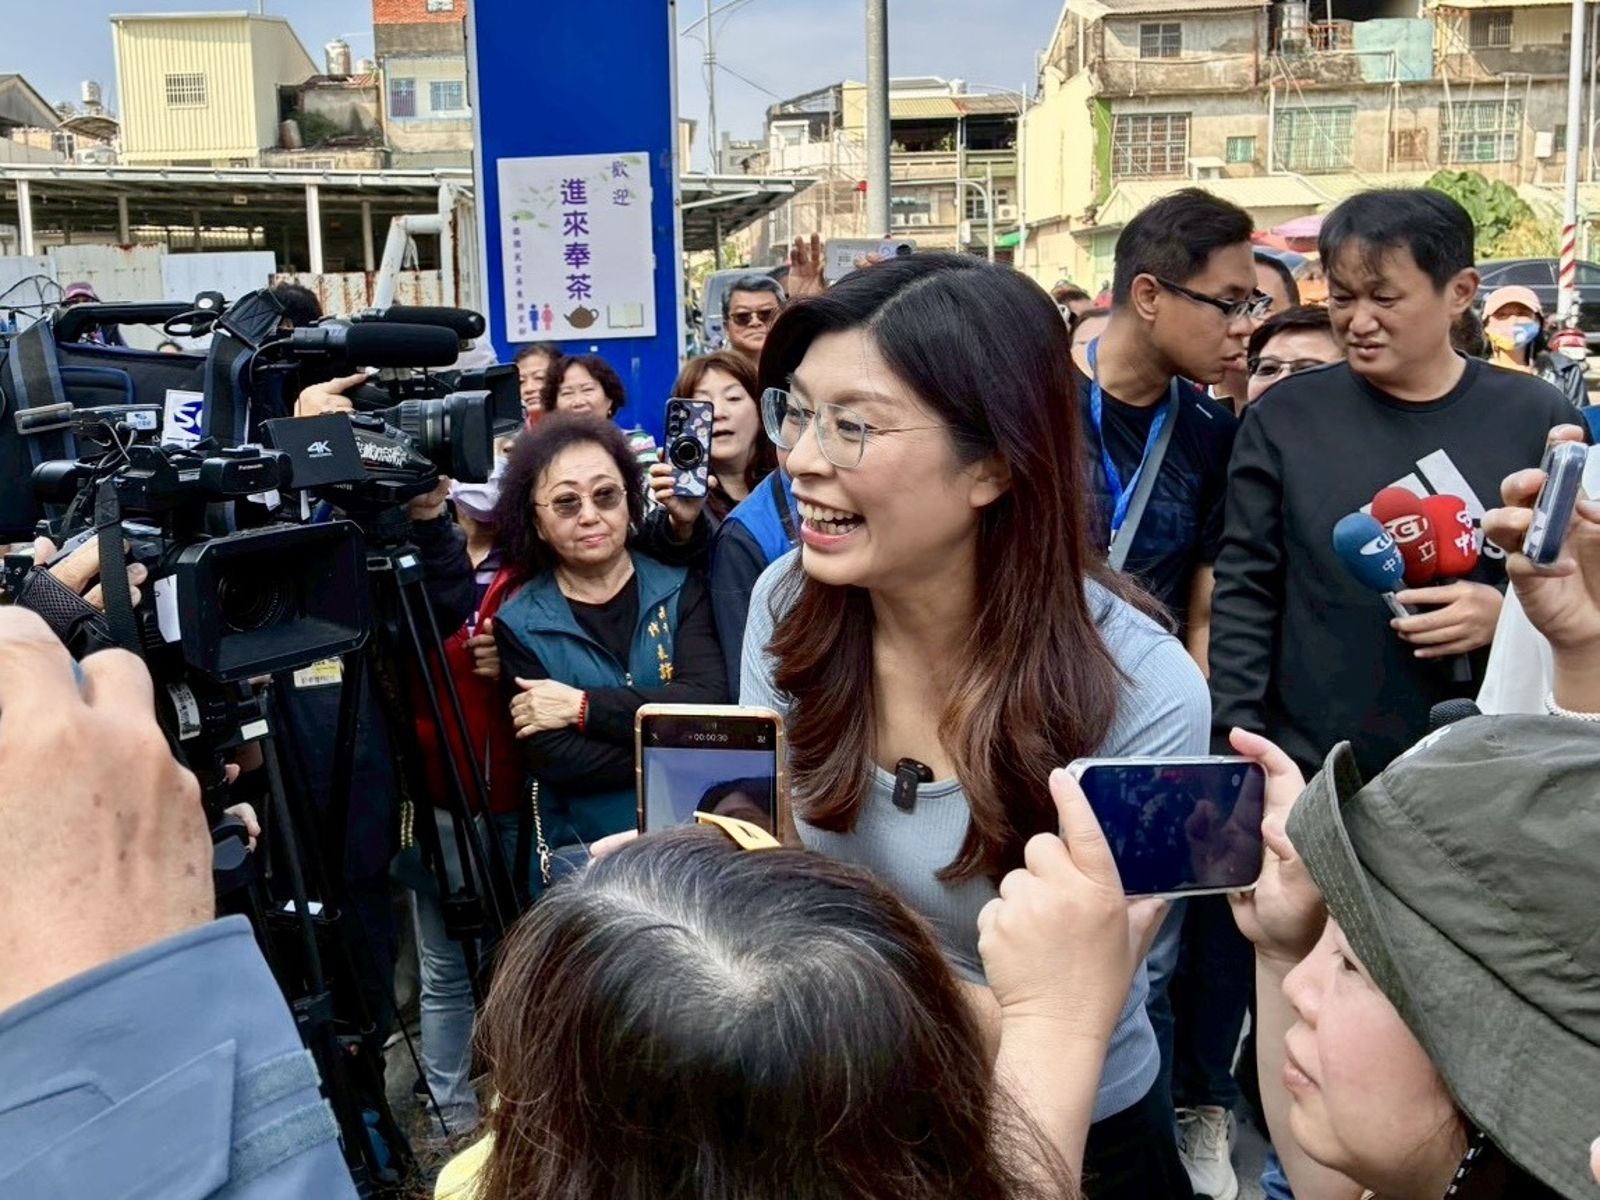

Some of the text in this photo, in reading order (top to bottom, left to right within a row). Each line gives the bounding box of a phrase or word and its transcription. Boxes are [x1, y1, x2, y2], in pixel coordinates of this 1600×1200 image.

[610, 160, 631, 207] 歡迎
[560, 178, 593, 301] 進來奉茶
[307, 440, 333, 453] 4K
